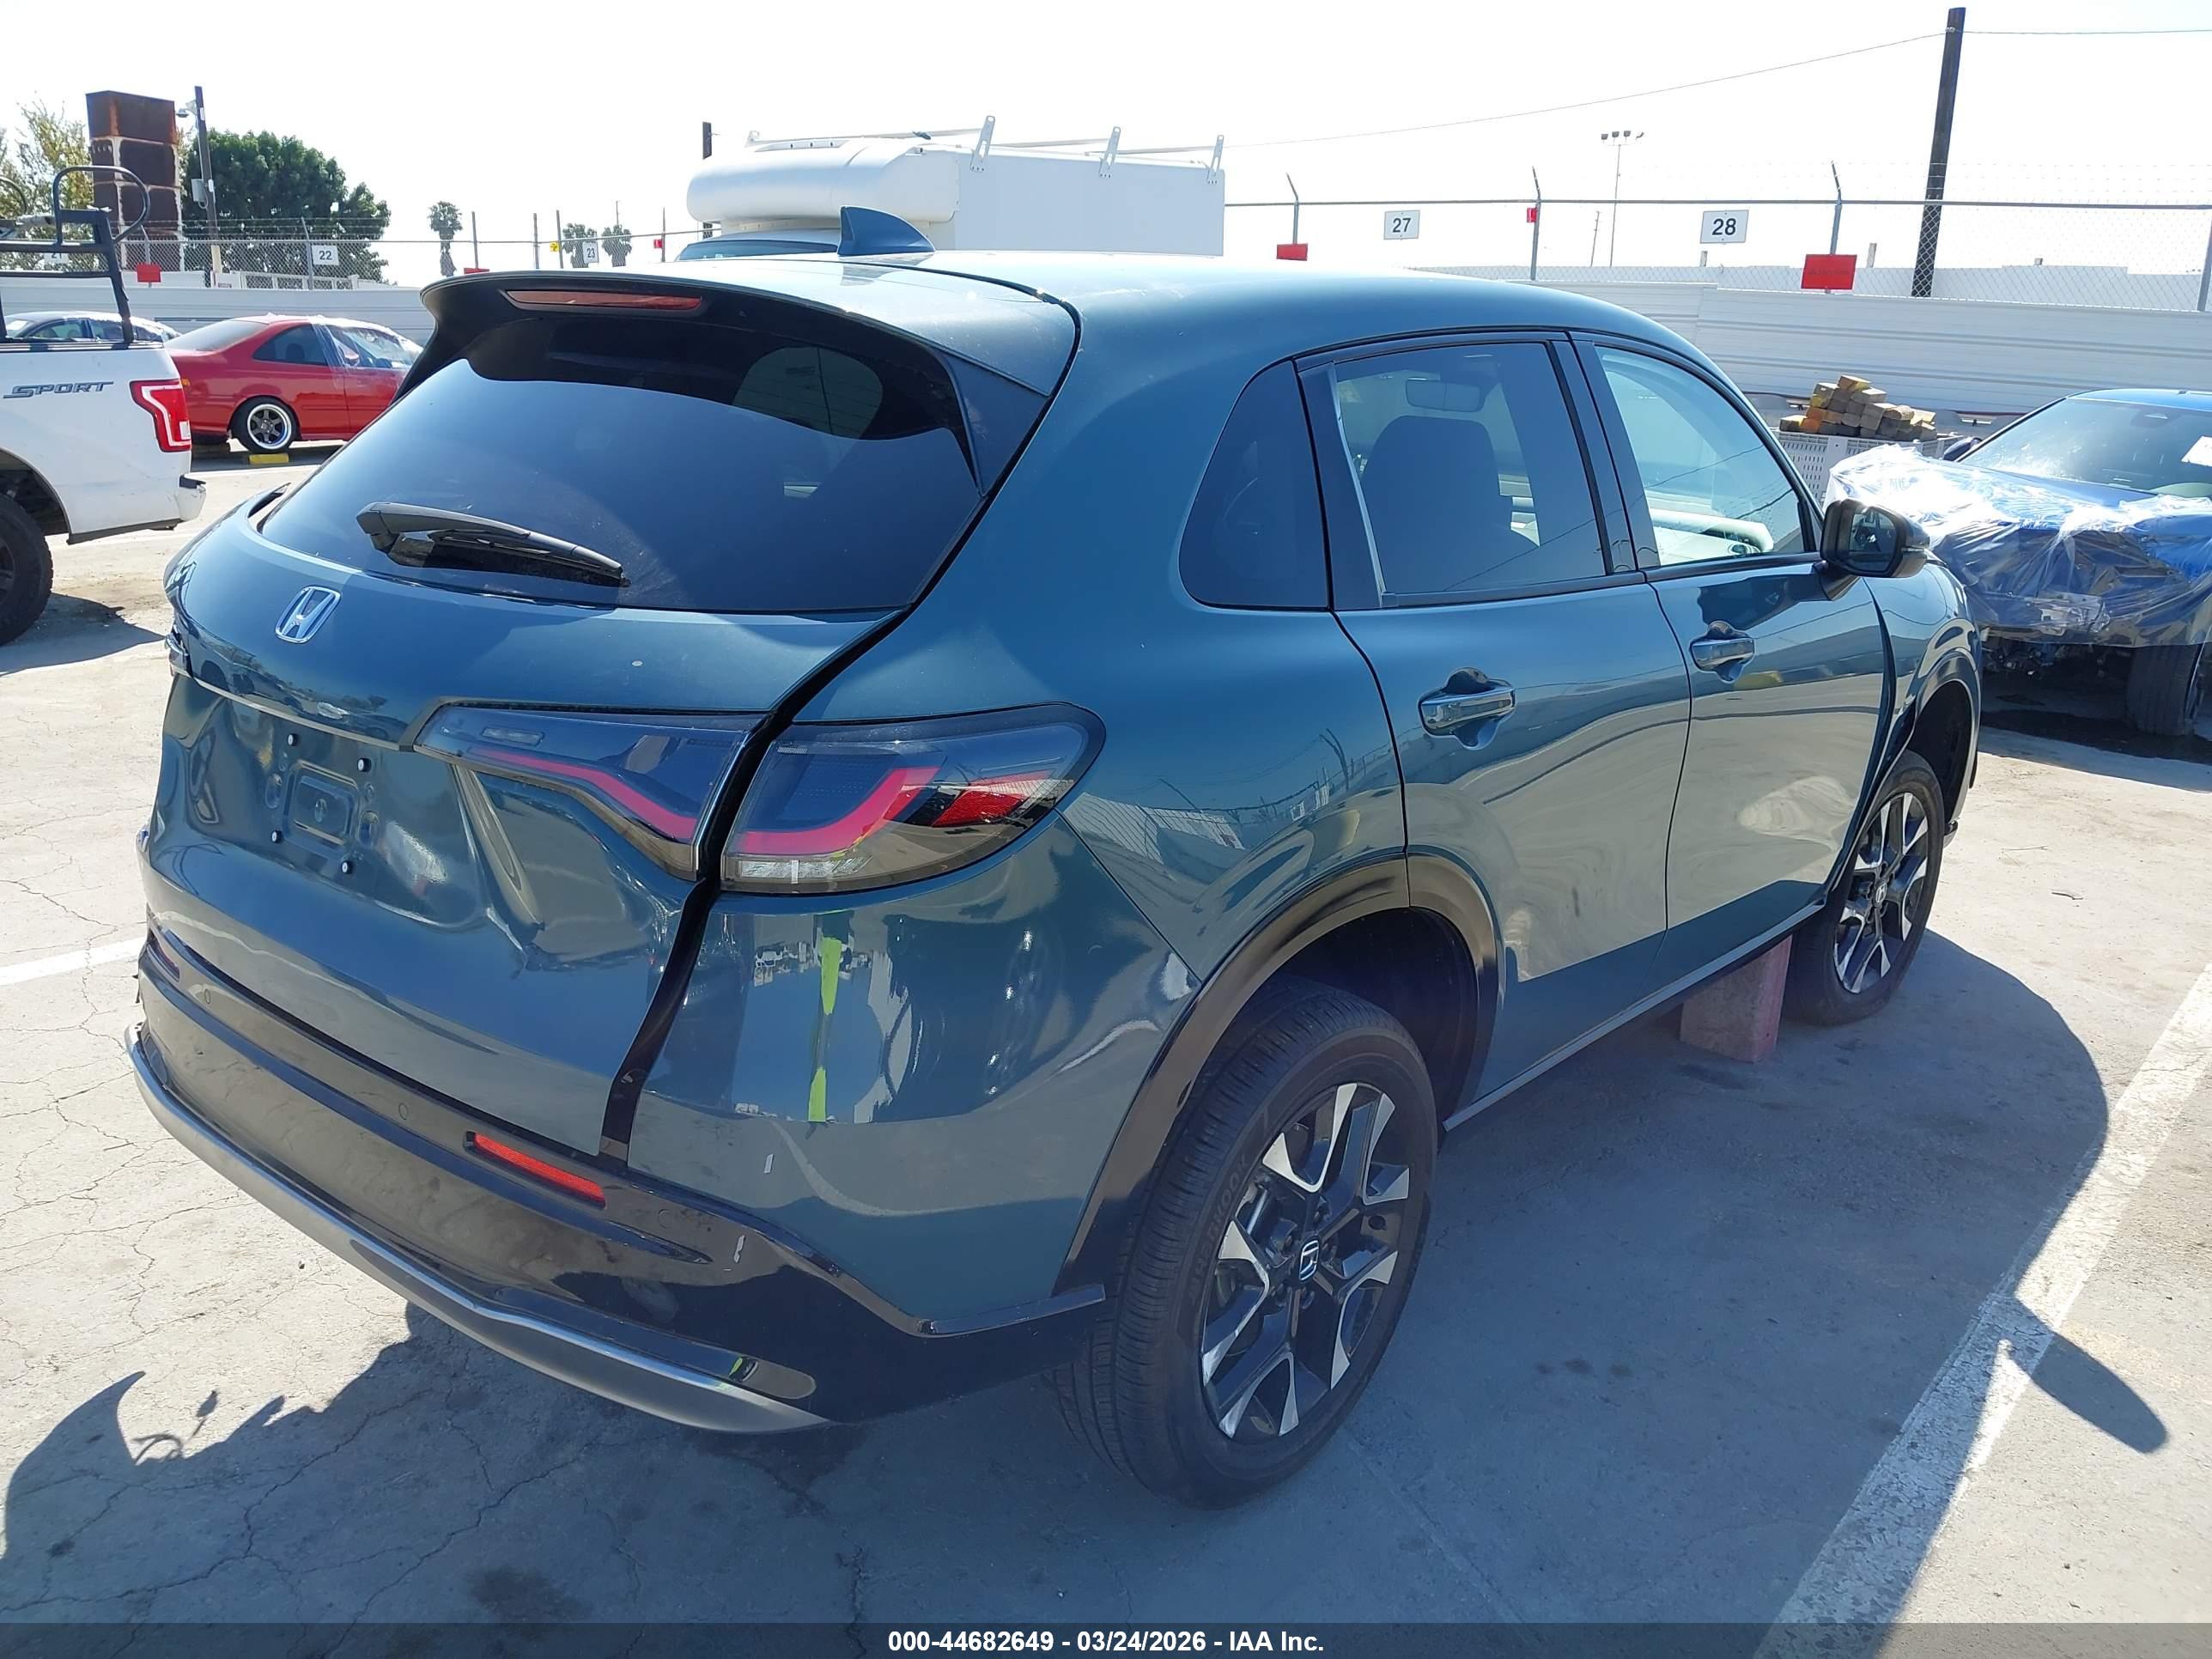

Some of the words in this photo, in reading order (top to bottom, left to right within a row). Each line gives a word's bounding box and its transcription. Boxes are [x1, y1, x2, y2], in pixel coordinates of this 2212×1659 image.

[1392, 217, 1412, 233] 27
[1712, 217, 1737, 236] 28
[319, 250, 333, 261] 22
[586, 247, 596, 259] 23
[3, 380, 114, 399] SPORT
